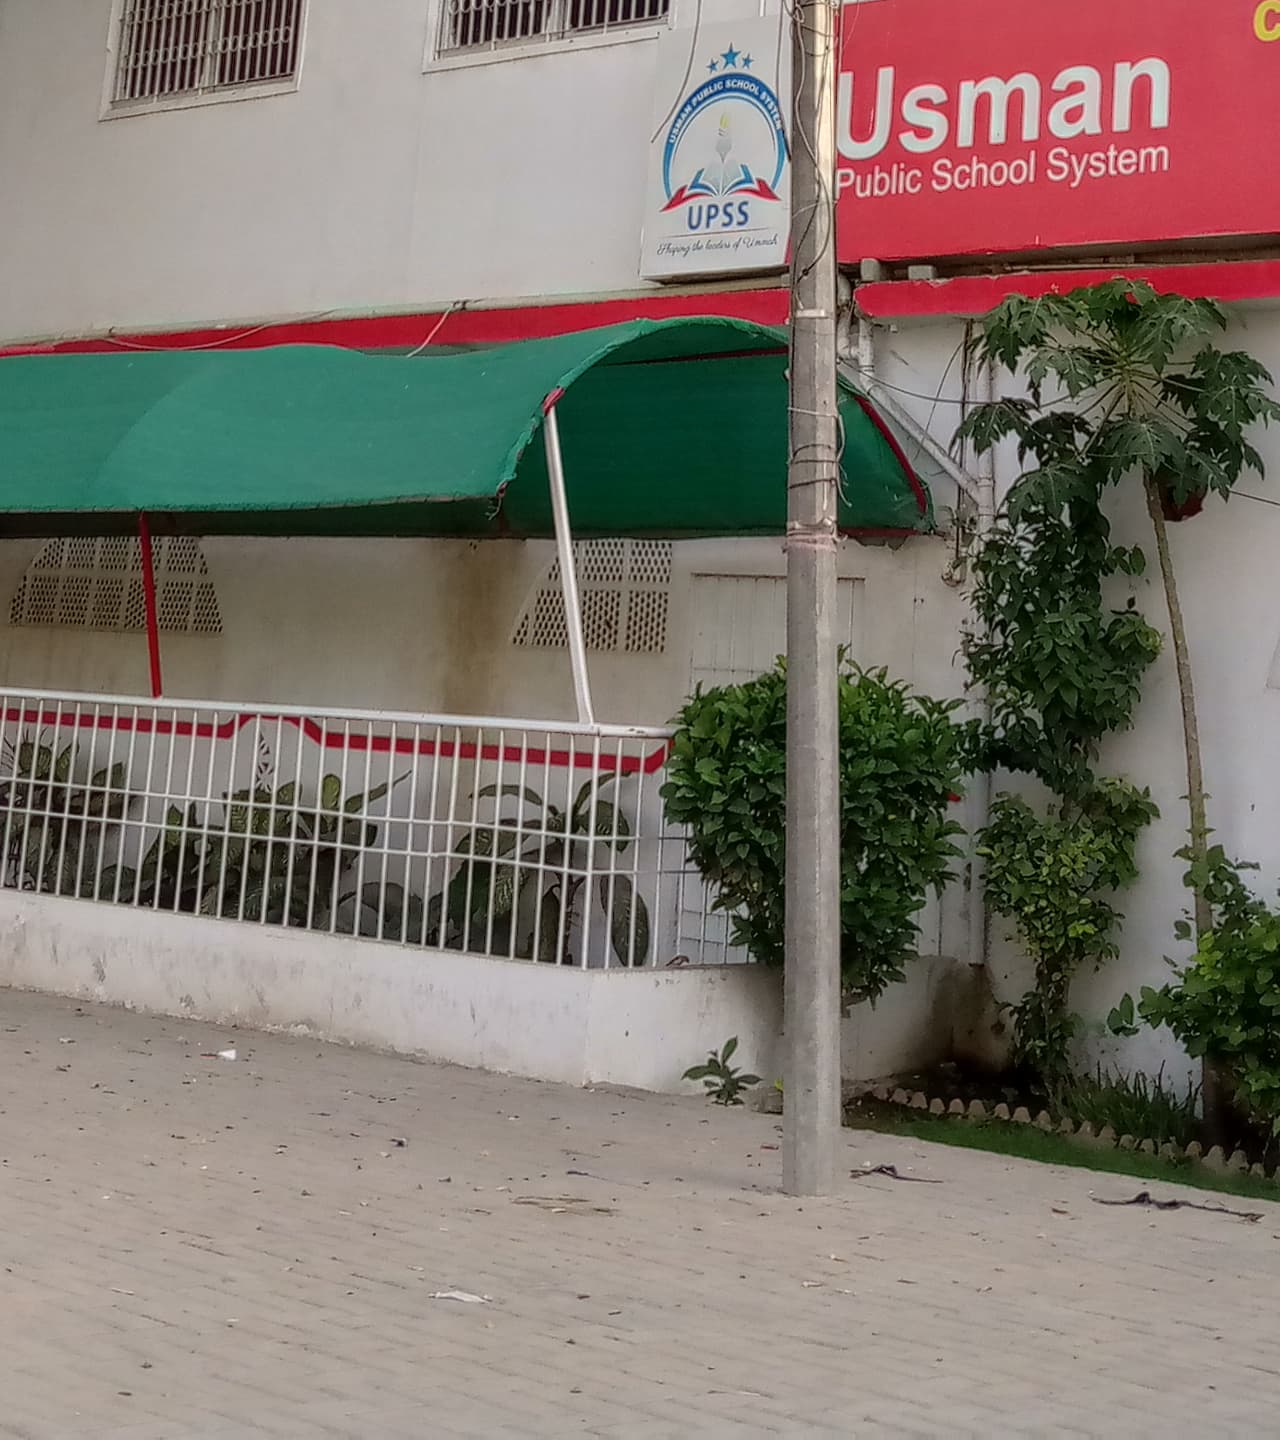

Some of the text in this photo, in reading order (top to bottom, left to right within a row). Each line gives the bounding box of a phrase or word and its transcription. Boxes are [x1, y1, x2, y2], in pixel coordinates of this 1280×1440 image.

[668, 78, 784, 144] USMAN PUBLIC SCHOOL SYSTEM
[837, 58, 1170, 161] Usman
[835, 144, 1170, 200] Public School System
[687, 200, 750, 231] UPSS
[691, 240, 704, 252] the
[733, 237, 741, 252] of
